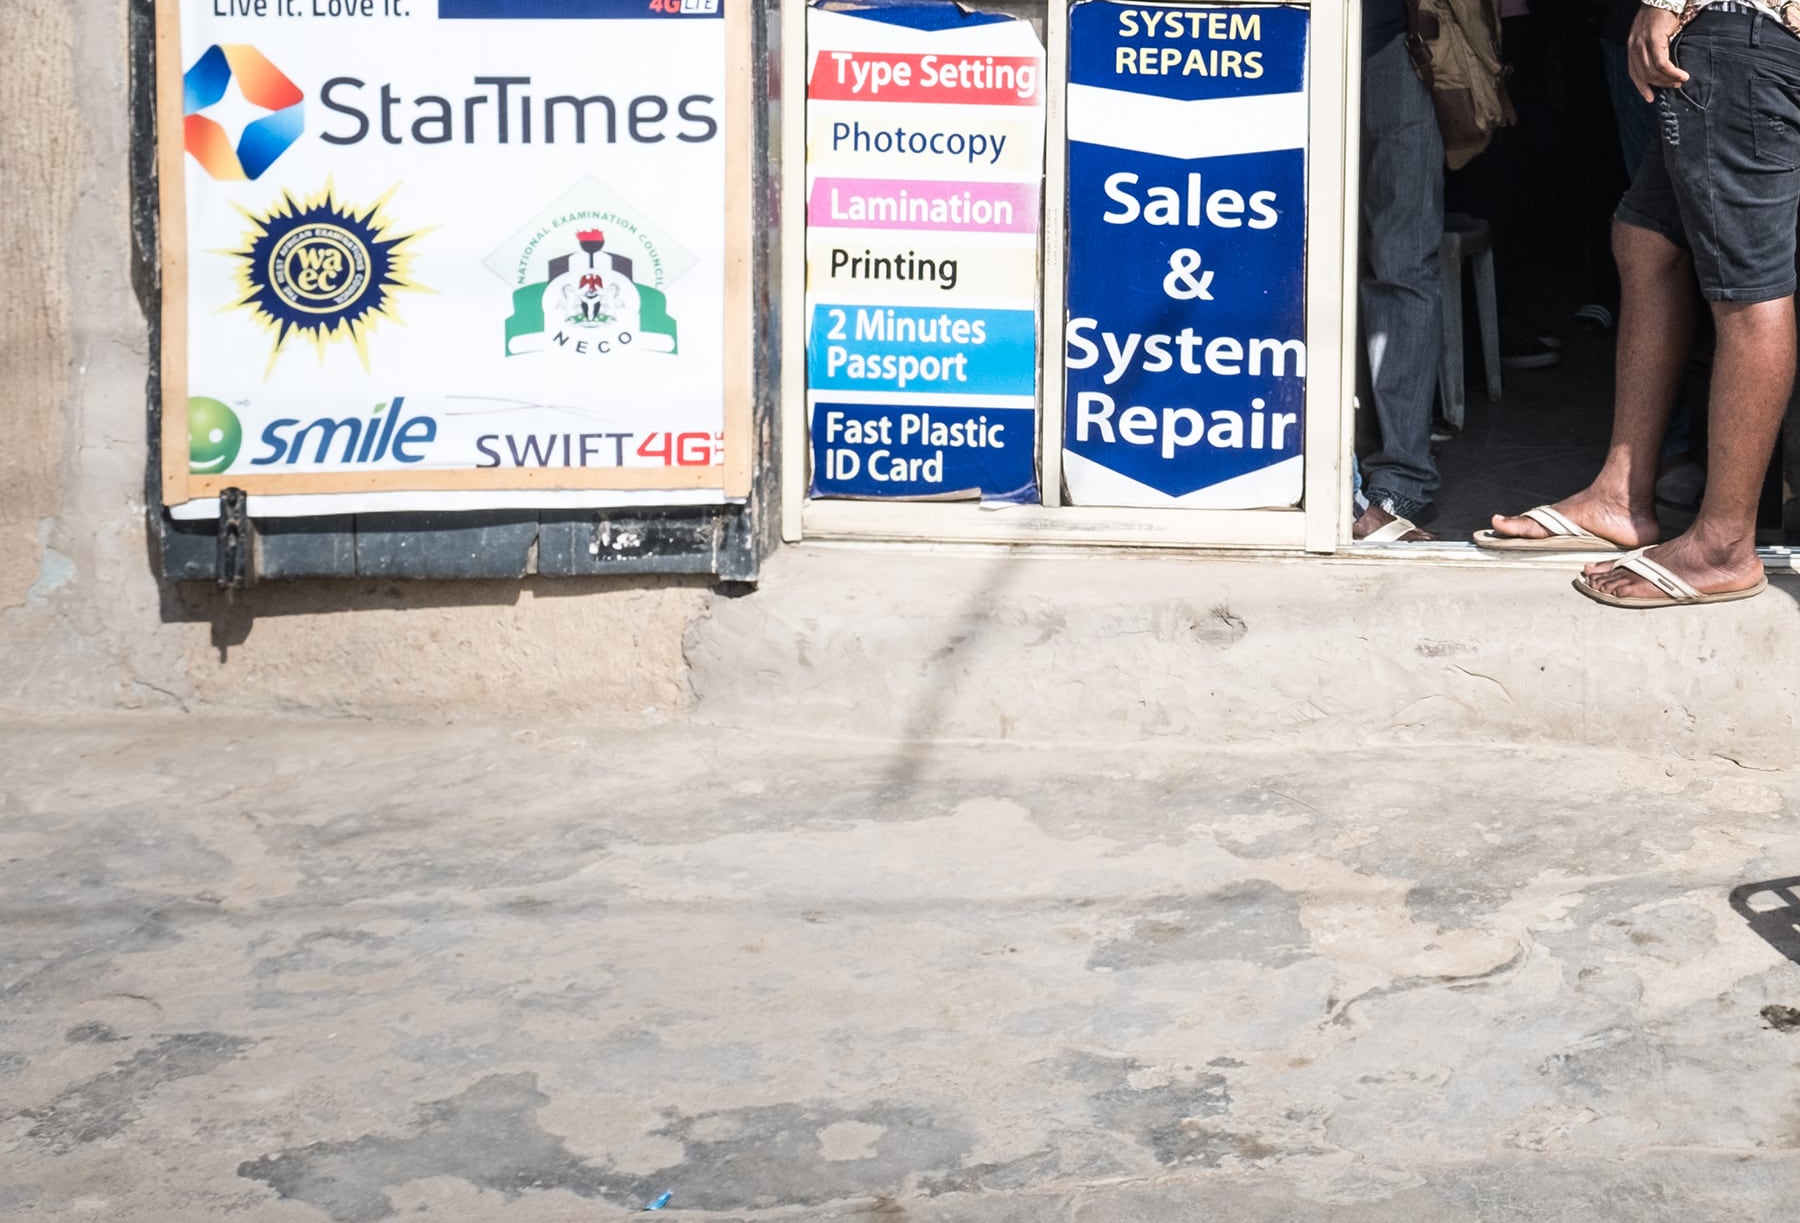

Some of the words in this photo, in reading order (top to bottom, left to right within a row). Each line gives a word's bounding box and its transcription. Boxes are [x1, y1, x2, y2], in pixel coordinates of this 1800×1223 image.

[1118, 10, 1262, 42] SYSTEM
[831, 53, 912, 93] Type
[919, 55, 1037, 99] Setting
[1115, 48, 1264, 79] REPAIRS
[319, 75, 718, 145] StarTimes
[832, 121, 1007, 164] Photocopy
[831, 188, 1013, 226] Lamination
[1103, 172, 1279, 230] Sales
[518, 227, 550, 285] NATIONAL
[551, 210, 637, 234] EXAMINATION
[638, 234, 664, 288] COUNCIL
[830, 248, 958, 290] Printing
[1162, 247, 1215, 301] &
[553, 330, 632, 354] NECO
[827, 309, 847, 341] 2
[855, 309, 986, 345] Minutes
[827, 346, 968, 388] Passport
[1065, 317, 1306, 385] System
[250, 396, 437, 466] smile
[826, 412, 893, 446] Fast
[900, 413, 1006, 449] Plastic
[1077, 391, 1297, 459] Repair
[826, 448, 859, 480] ID
[868, 449, 943, 483] Card
